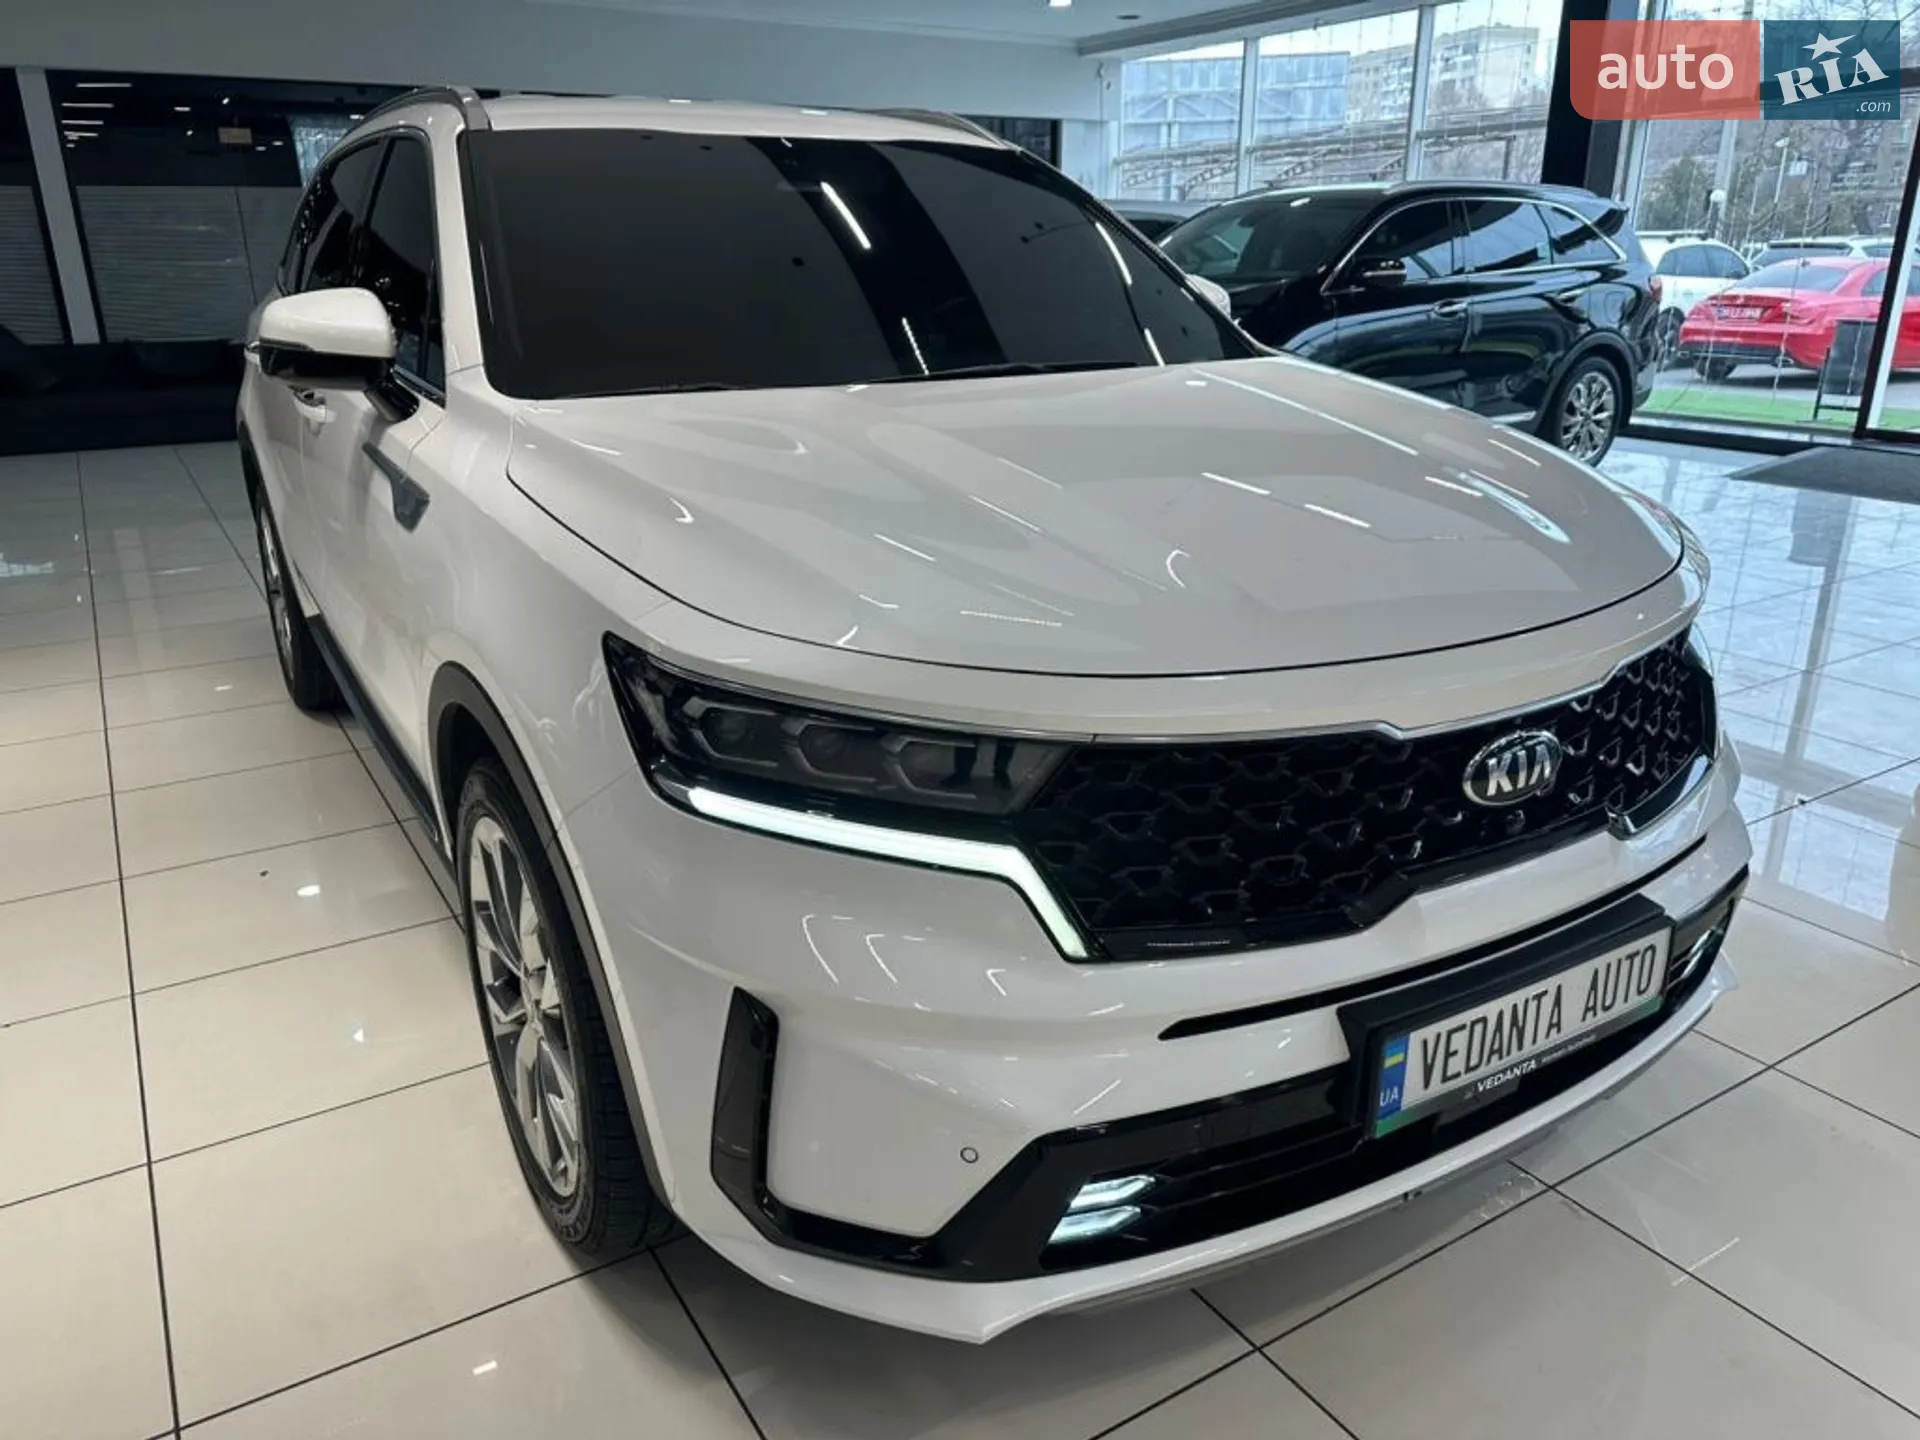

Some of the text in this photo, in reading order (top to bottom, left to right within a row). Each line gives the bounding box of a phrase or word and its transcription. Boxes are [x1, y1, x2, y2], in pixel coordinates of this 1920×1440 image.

[1486, 743, 1551, 796] KIA
[1421, 944, 1658, 1090] VEDANTA AUTO
[1380, 1086, 1400, 1107] UA
[1477, 1059, 1537, 1092] VEDANTA
